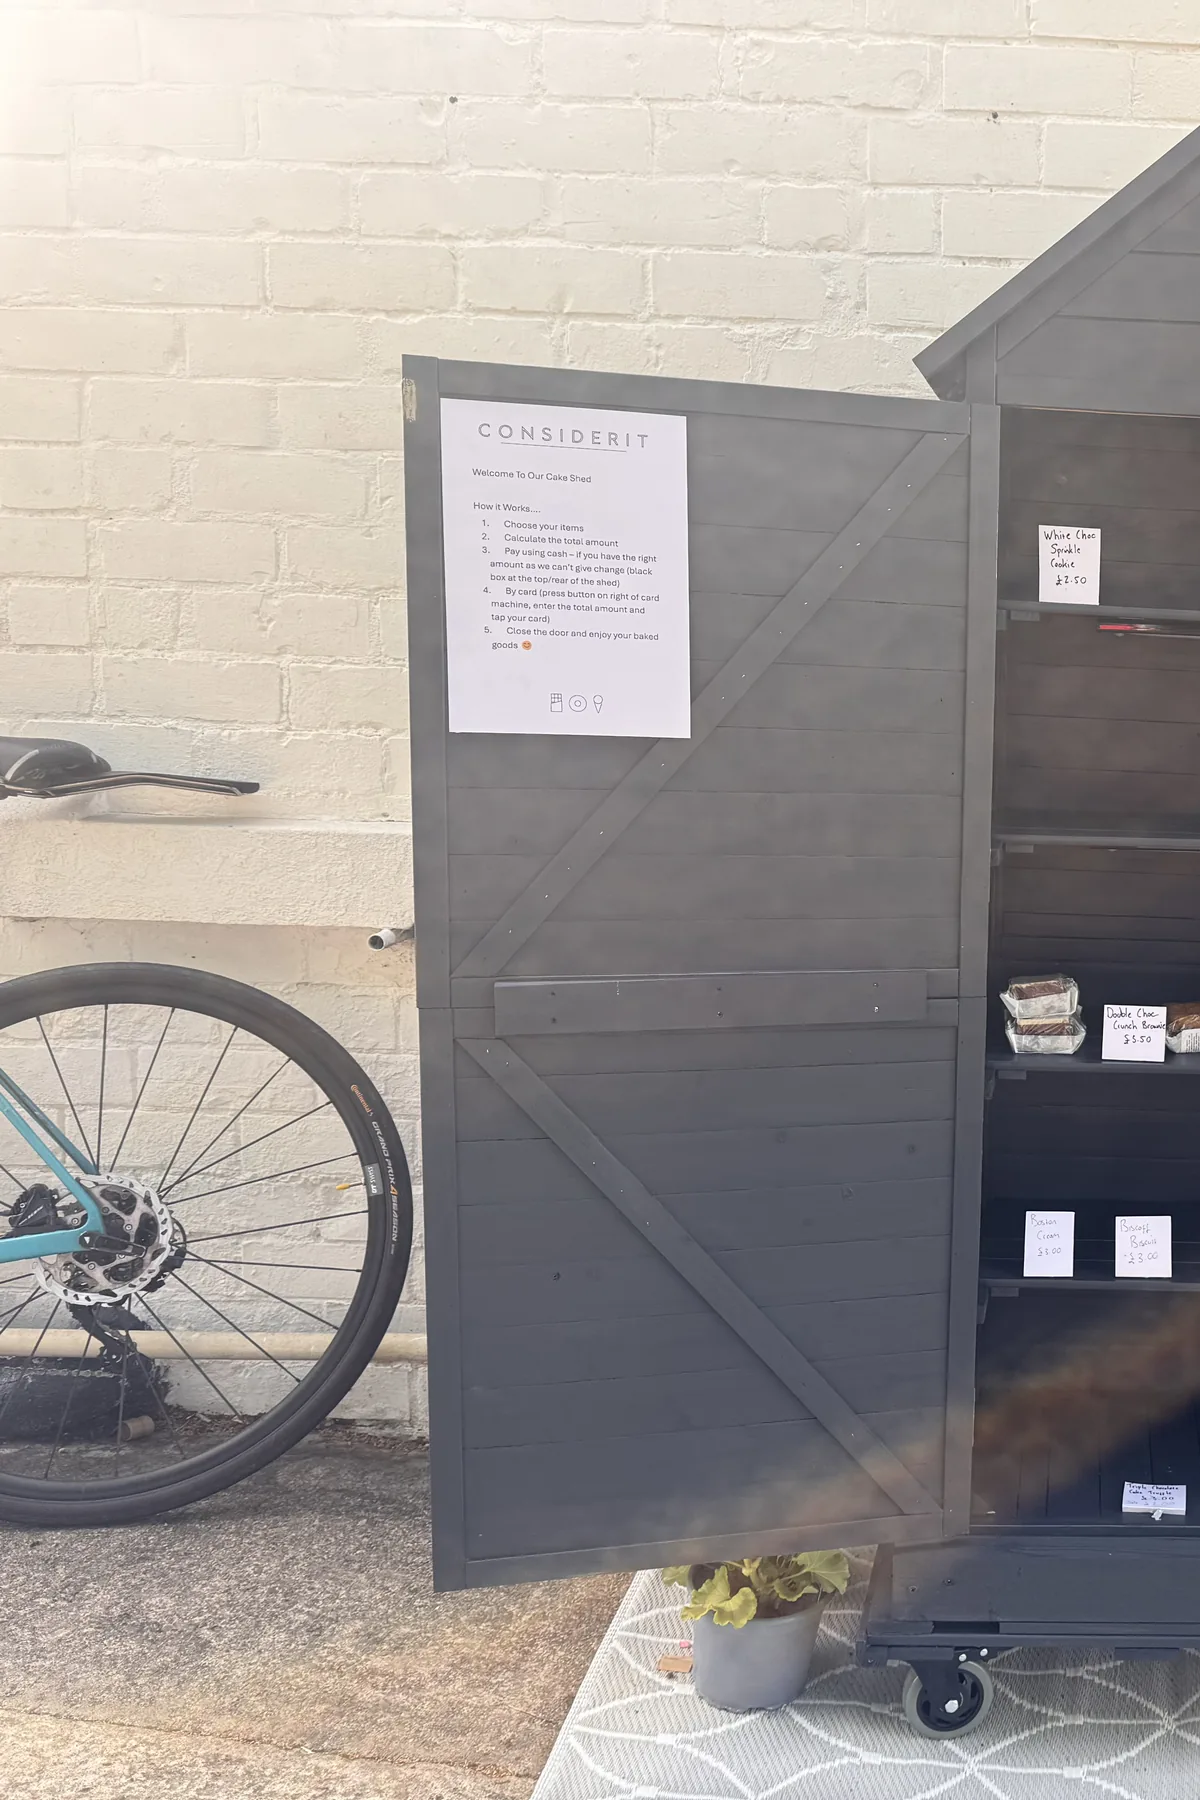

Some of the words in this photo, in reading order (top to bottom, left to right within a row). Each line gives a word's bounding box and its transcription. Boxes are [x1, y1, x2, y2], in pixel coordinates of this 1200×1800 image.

[478, 423, 648, 448] CONSIDERIT
[472, 468, 514, 478] Welcome
[516, 470, 526, 479] To
[528, 472, 544, 480] Our
[546, 473, 568, 482] Cake
[570, 474, 592, 483] Shed
[474, 502, 494, 510] How
[504, 520, 538, 530] Choose
[560, 524, 584, 532] items
[482, 532, 490, 540] 2.
[504, 534, 546, 544] Calculate
[585, 540, 618, 548] amount
[1044, 529, 1071, 540] White
[1076, 530, 1096, 540] Choc
[504, 547, 520, 557] Pay
[522, 548, 546, 558] using
[600, 552, 620, 560] have
[622, 554, 636, 562] the
[638, 554, 657, 564] right
[1050, 544, 1080, 558] Sprinkle
[1050, 558, 1075, 568] Cookie
[552, 564, 574, 572] can't
[575, 564, 592, 574] give
[594, 566, 624, 576] change
[626, 566, 652, 576] (black
[534, 576, 568, 584] top/rear
[596, 578, 620, 588] shed)
[1056, 574, 1087, 586] £2.50
[506, 587, 516, 596] By
[540, 589, 566, 598] (press
[568, 590, 596, 598] button
[610, 592, 629, 602] right
[491, 600, 531, 610] machine,
[491, 614, 506, 622] tap
[528, 616, 550, 624] card)
[506, 626, 532, 636] Close
[548, 628, 569, 636] door
[588, 631, 612, 640] enjoy
[613, 632, 632, 640] your
[634, 632, 658, 640] baked
[492, 642, 518, 650] goods
[1106, 1006, 1132, 1018] Double
[1136, 1008, 1160, 1018] Choc
[1113, 1020, 1138, 1030] Crunch
[1142, 1021, 1166, 1030] Brownie
[372, 1121, 390, 1158] GRAND
[386, 1158, 396, 1188] PRIX
[368, 1166, 376, 1184] SWISS
[371, 1184, 377, 1194] DT
[1030, 1214, 1057, 1227] Boston
[1120, 1219, 1151, 1234] Biscoff
[1036, 1230, 1060, 1240] Cream
[1038, 1247, 1062, 1256] £3.00
